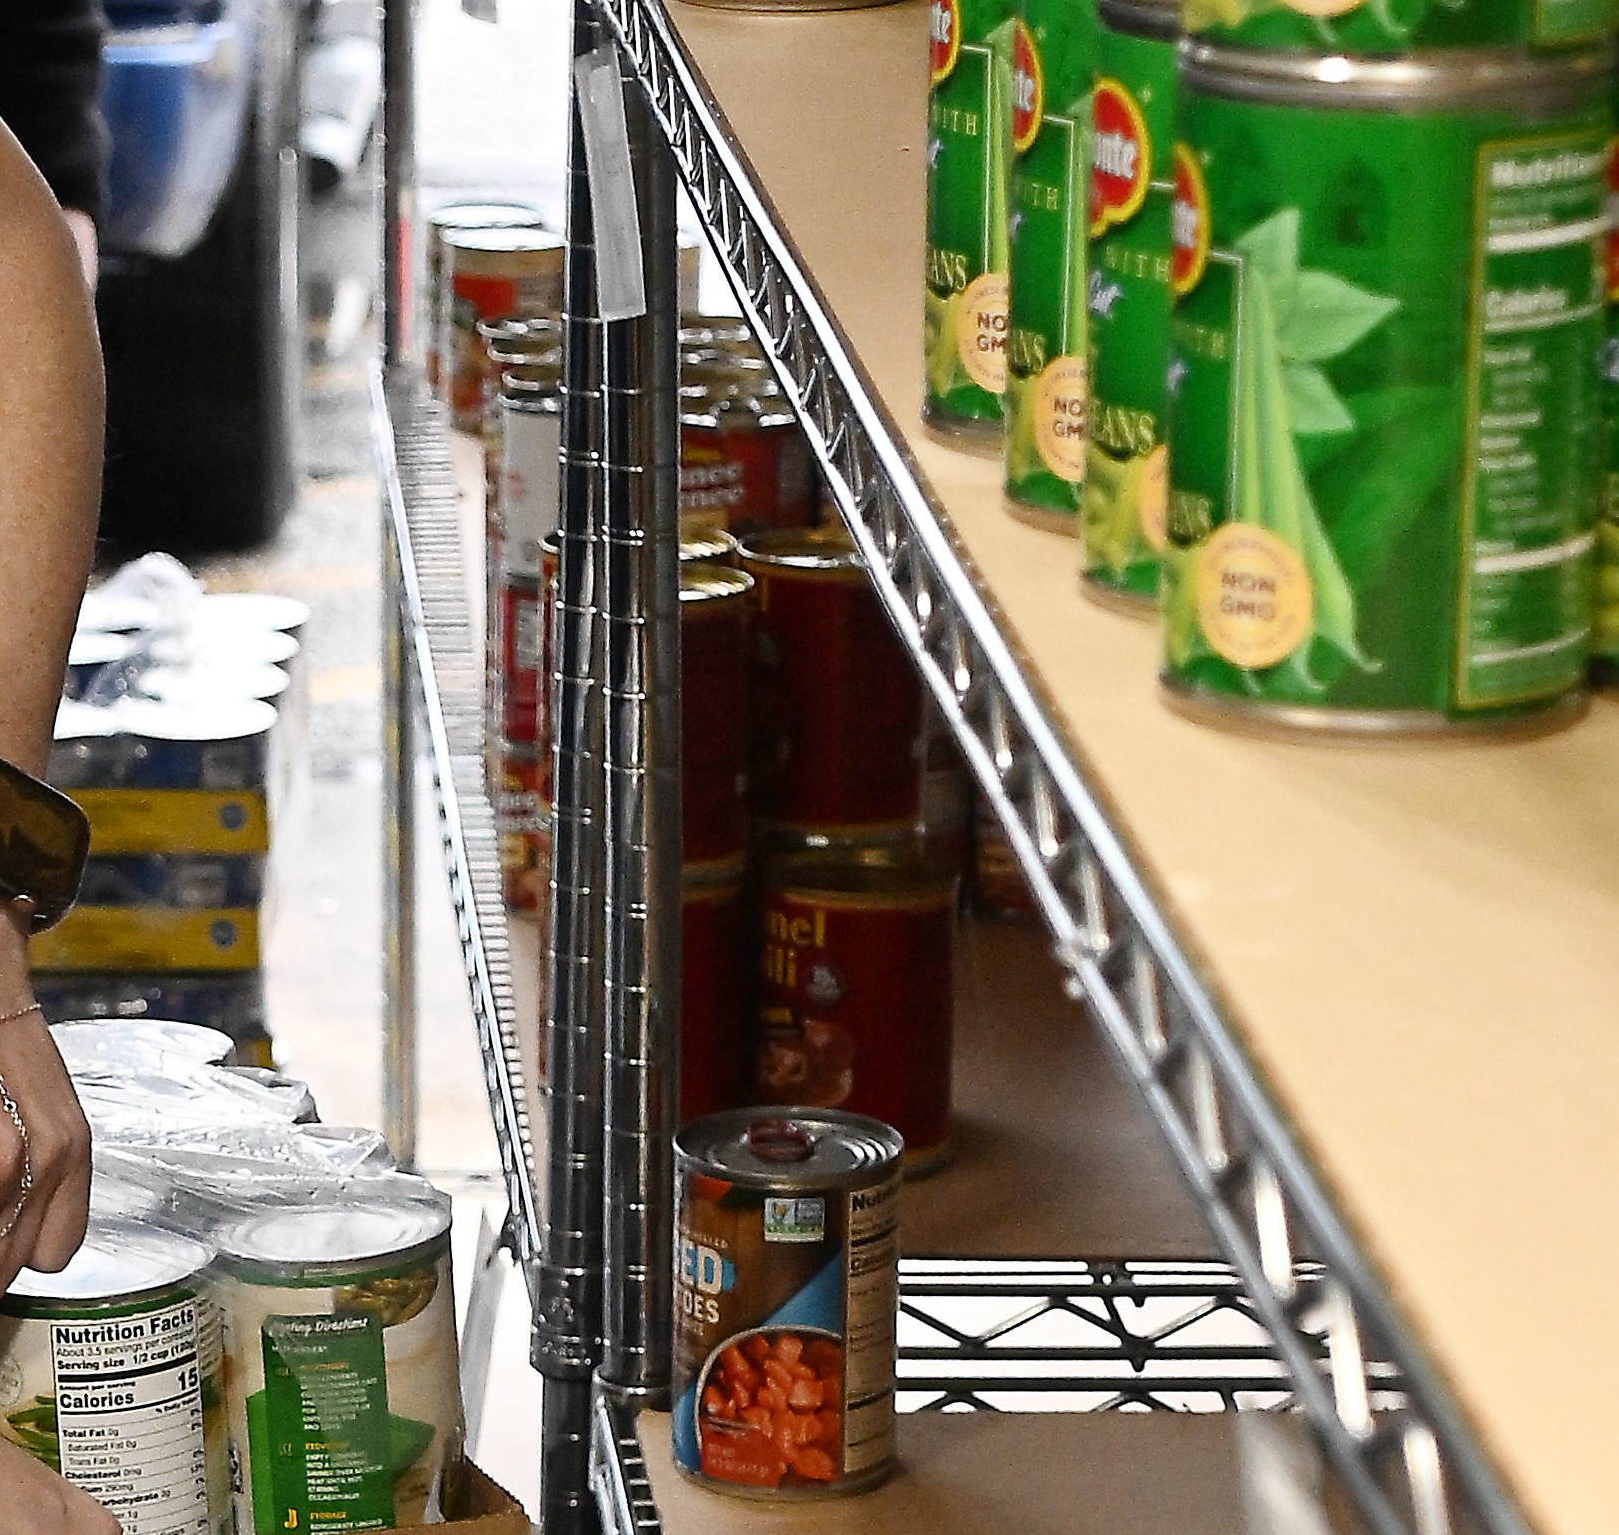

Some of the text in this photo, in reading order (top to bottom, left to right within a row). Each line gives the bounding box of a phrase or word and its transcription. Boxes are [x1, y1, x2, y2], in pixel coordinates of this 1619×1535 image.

[976, 312, 1007, 332] NO
[976, 333, 1007, 354] GM
[1054, 396, 1084, 416] NO
[56, 1309, 195, 1344] Nutrition Facts
[57, 1359, 99, 1370] Serving
[103, 1358, 125, 1367] size
[133, 1352, 148, 1364] 1/2
[178, 1367, 198, 1390] 15
[60, 1391, 134, 1408] Calories
[62, 1429, 86, 1437] Total
[89, 1429, 105, 1437] Fat
[65, 1470, 121, 1479] Cholesterol
[100, 1492, 159, 1506] arbohydrate
